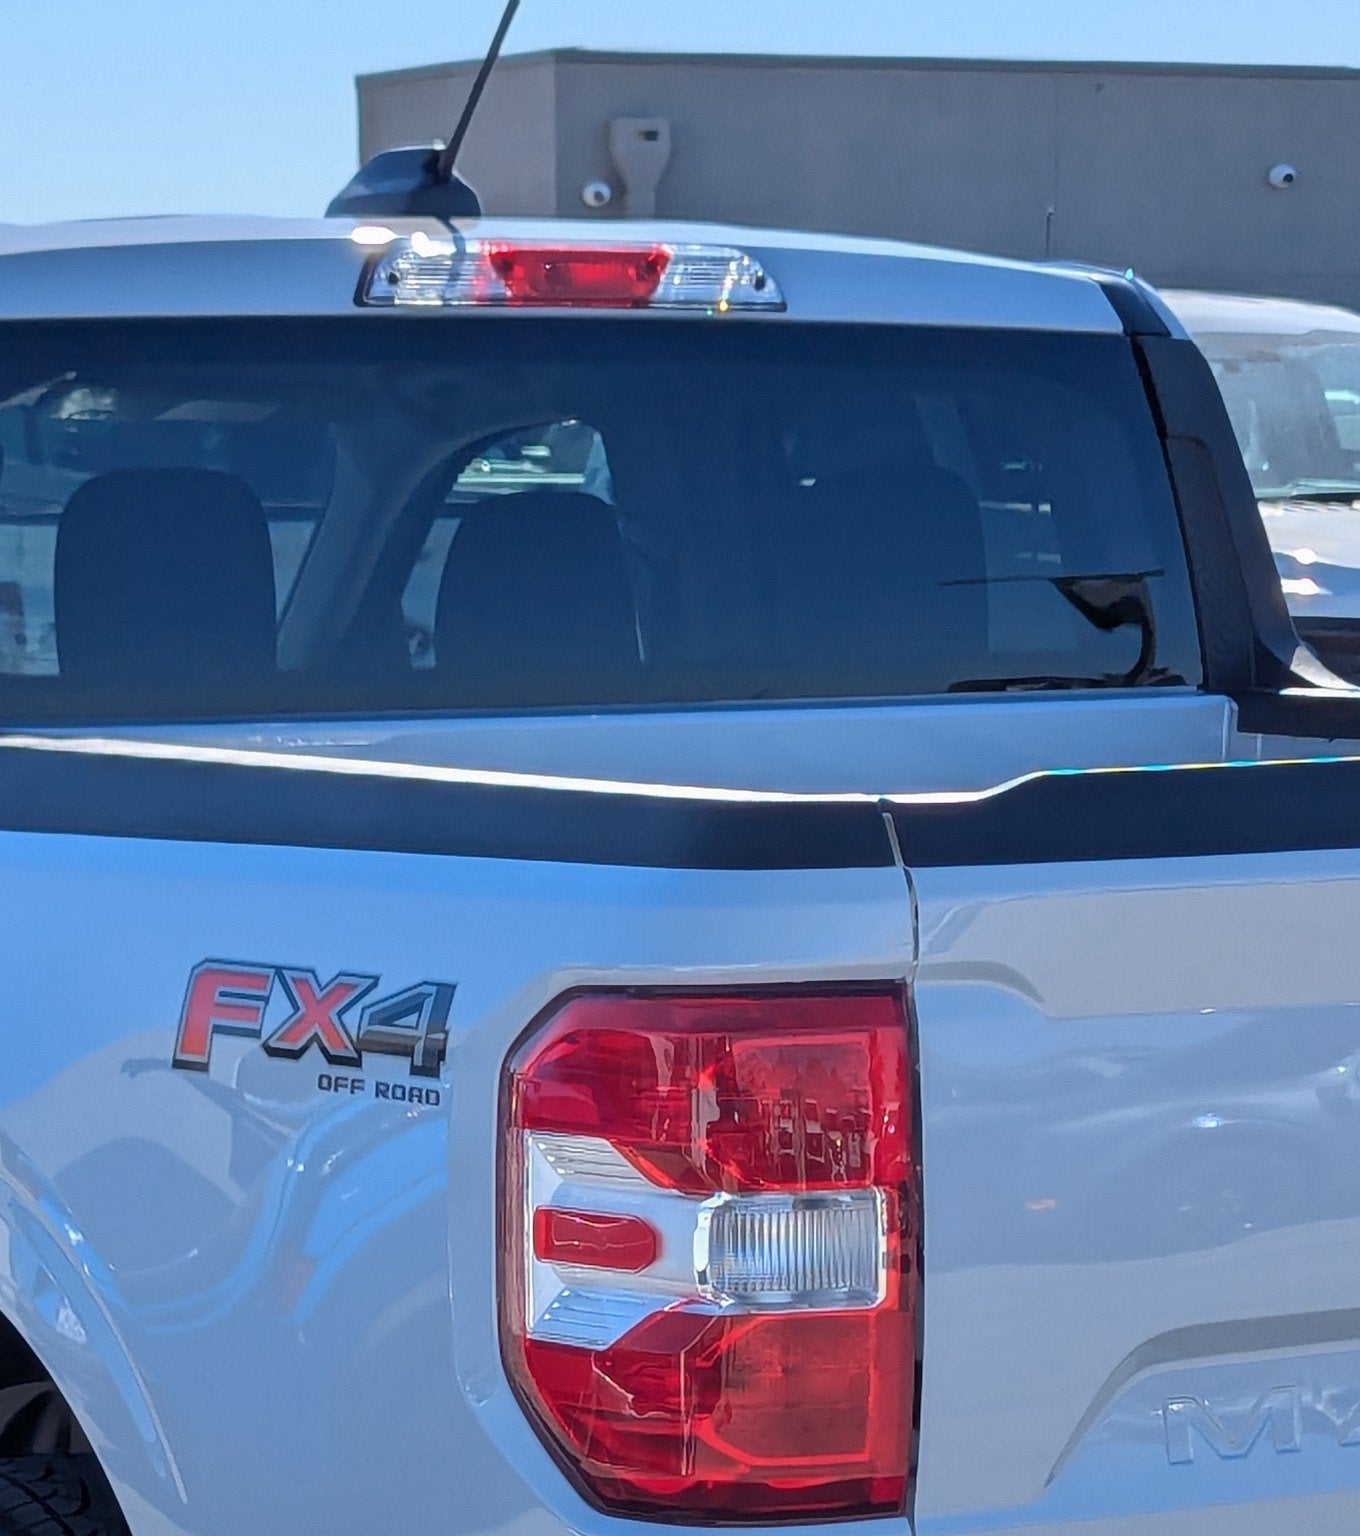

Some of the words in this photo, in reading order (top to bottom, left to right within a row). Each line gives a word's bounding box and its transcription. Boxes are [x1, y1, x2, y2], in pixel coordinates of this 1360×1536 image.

[172, 957, 458, 1078] FX4
[317, 1073, 365, 1095] OFF
[374, 1081, 440, 1106] ROAD
